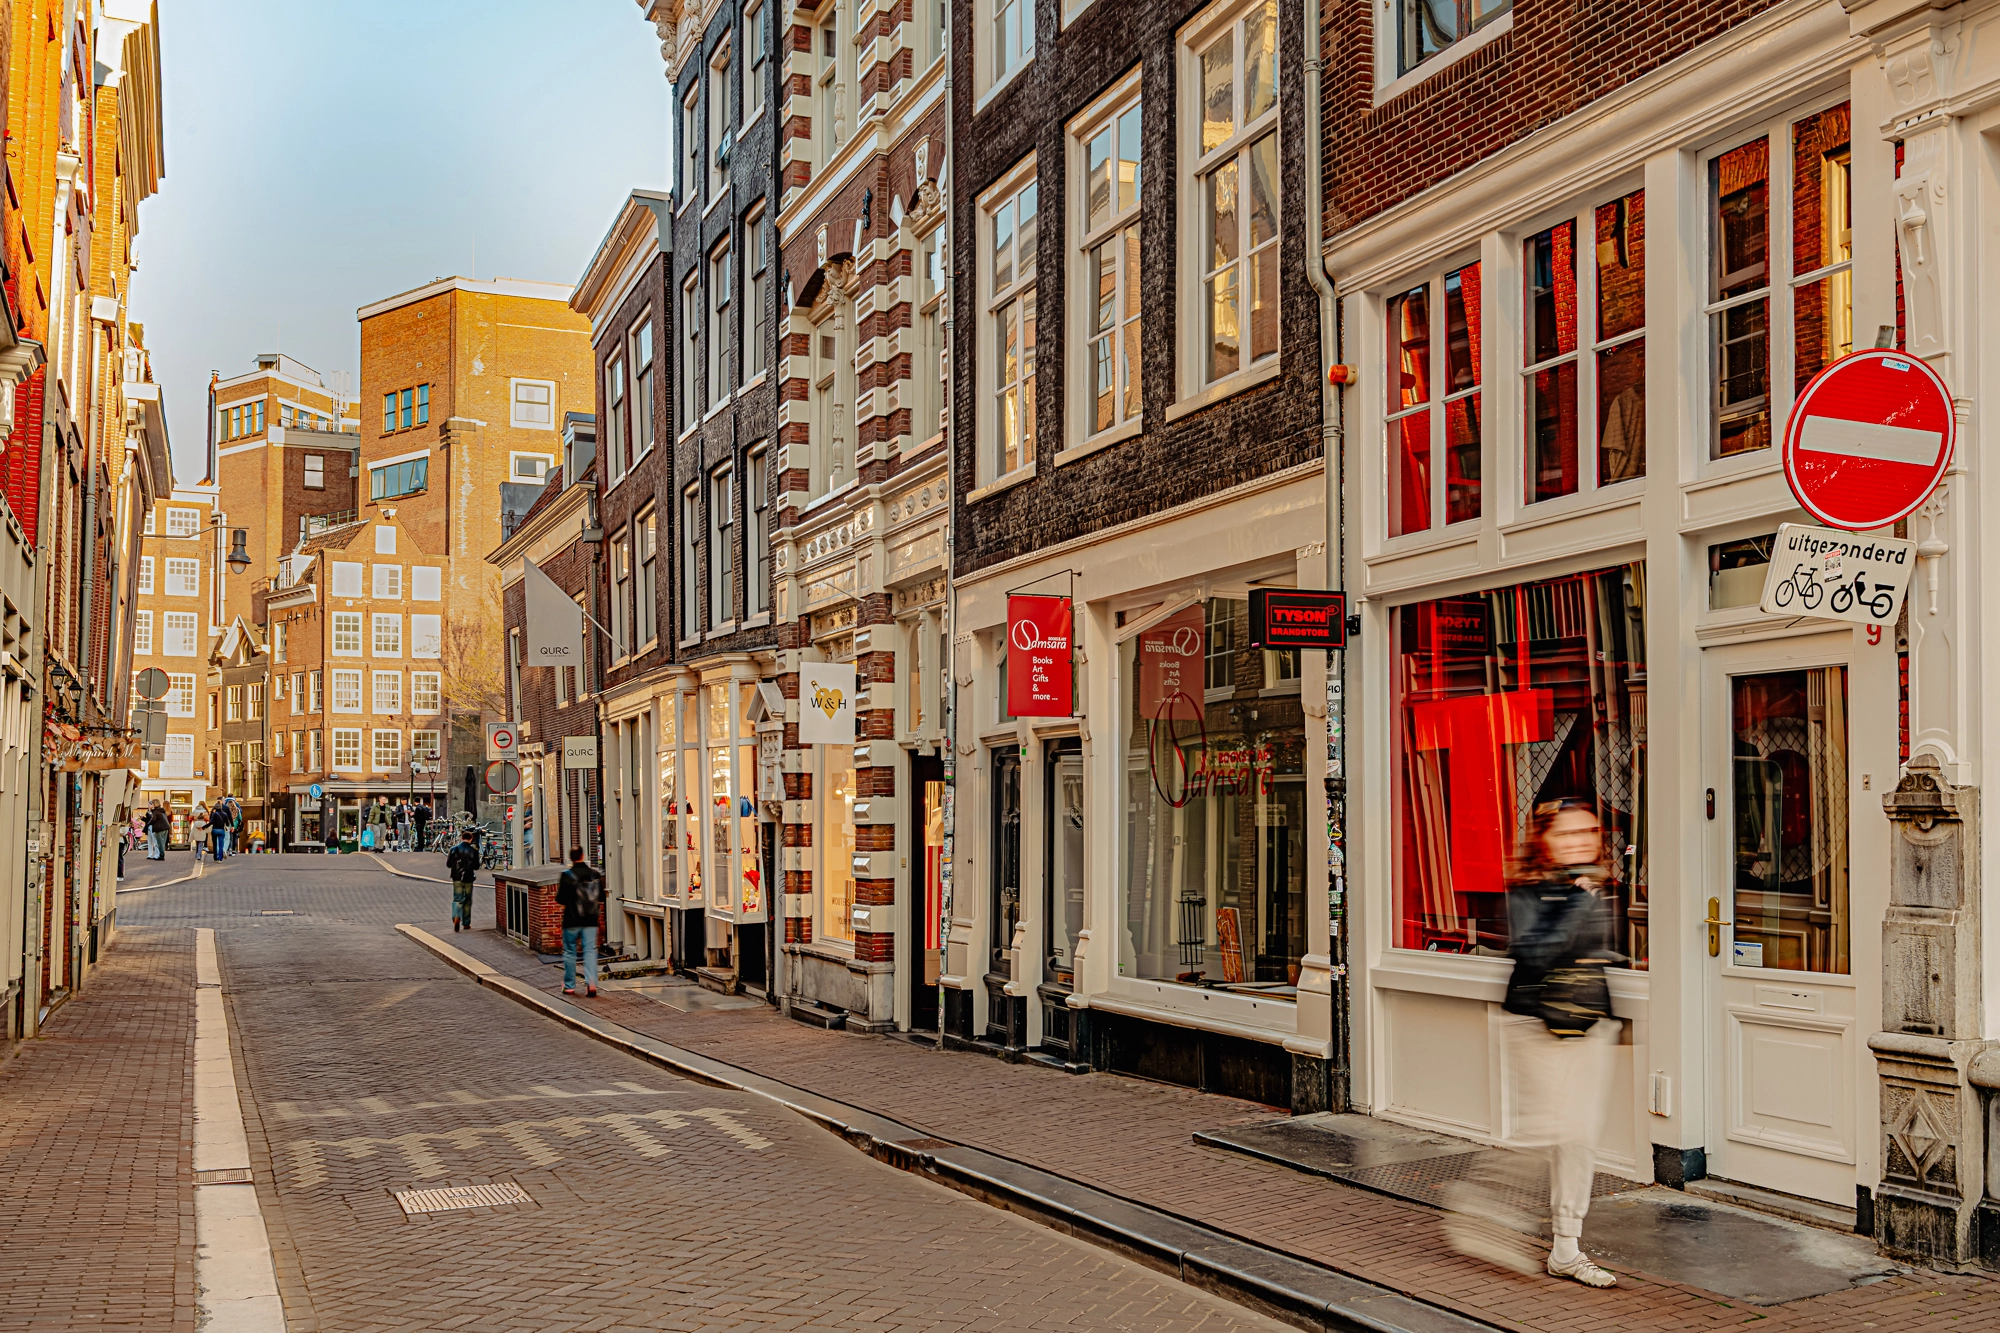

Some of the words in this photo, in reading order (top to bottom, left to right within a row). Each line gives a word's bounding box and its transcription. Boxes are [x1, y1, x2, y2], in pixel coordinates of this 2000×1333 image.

[1788, 533, 1908, 565] uitgezonderd
[1273, 609, 1328, 623] TYSON
[1271, 627, 1330, 637] BRANDSTORE
[540, 646, 571, 655] QURC.
[1032, 656, 1053, 665] Books
[1032, 665, 1043, 674] Art
[1032, 674, 1049, 683] Gifts
[1032, 683, 1040, 692] &
[1032, 693, 1051, 701] more
[810, 697, 823, 709] W
[824, 697, 835, 710] &
[838, 698, 848, 710] H
